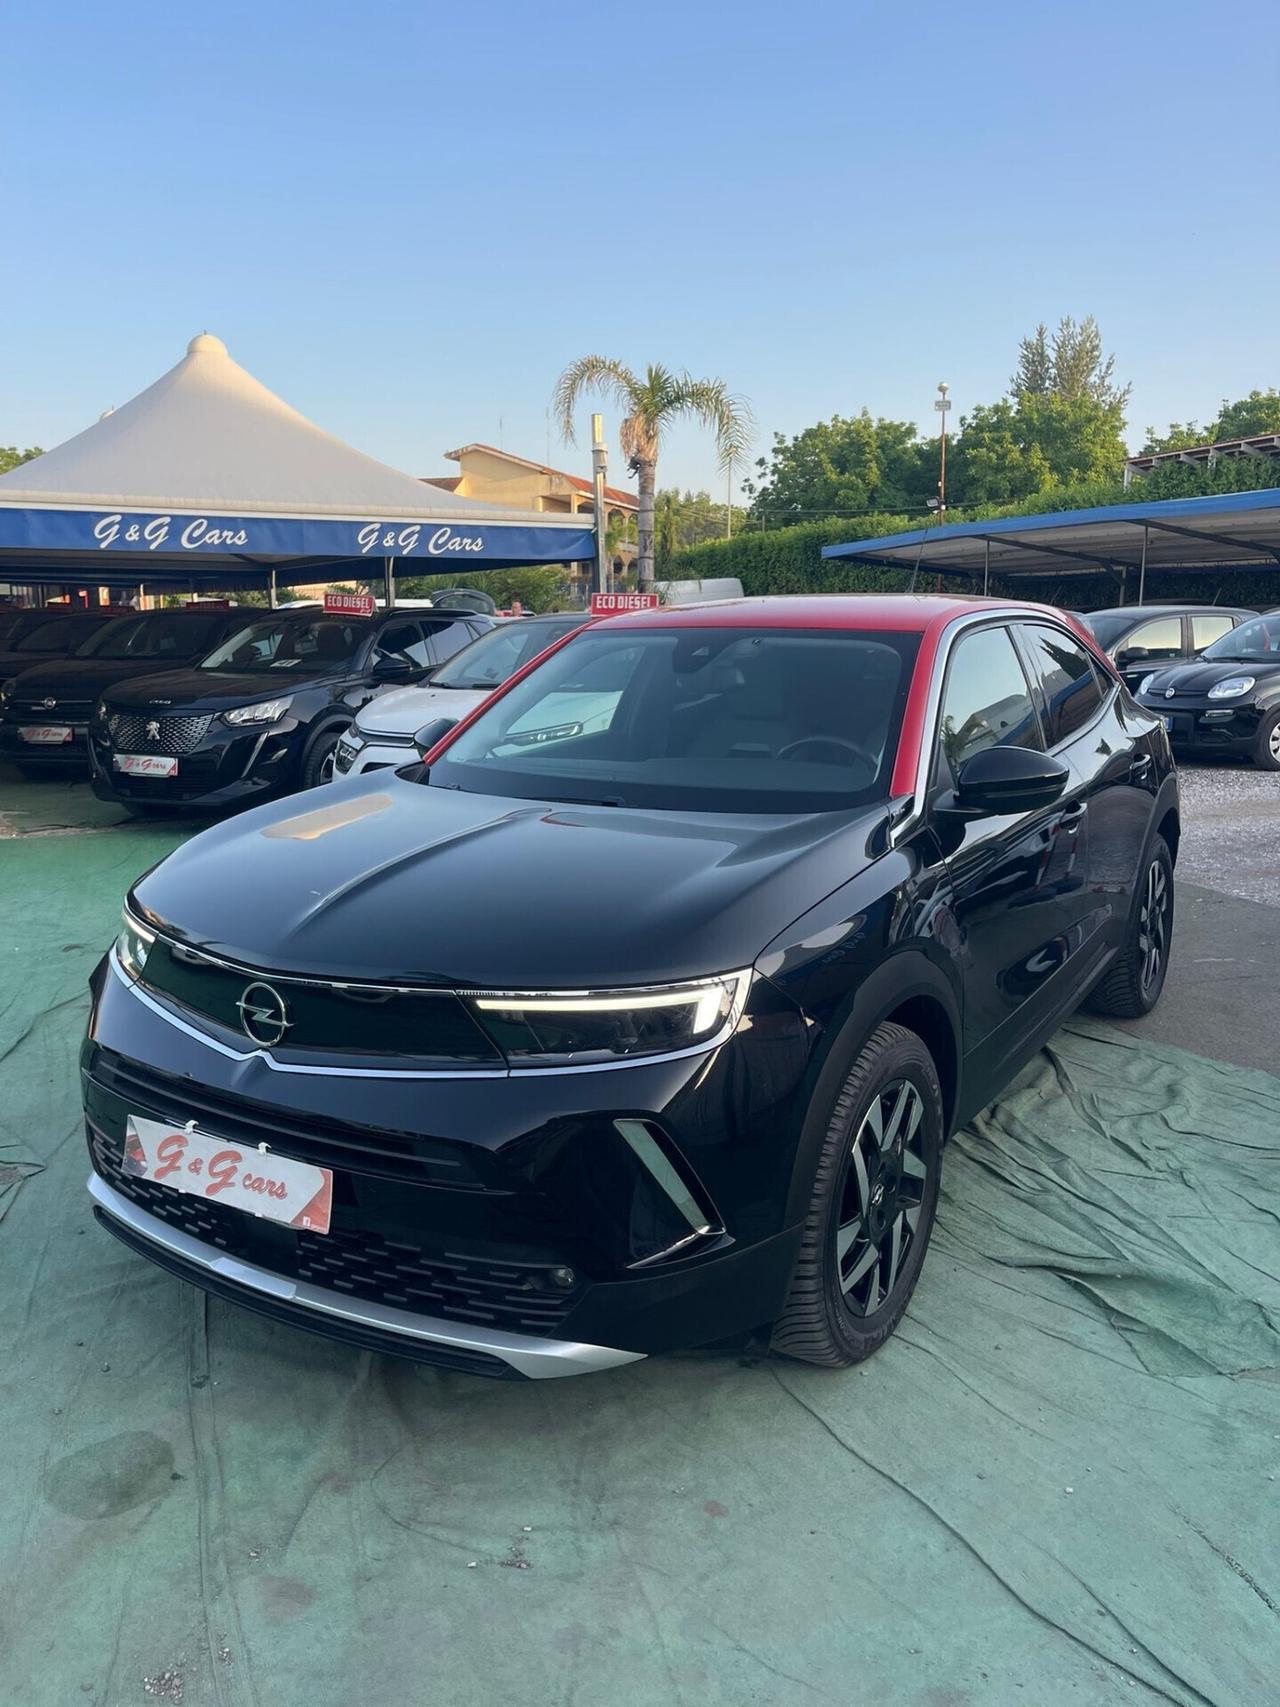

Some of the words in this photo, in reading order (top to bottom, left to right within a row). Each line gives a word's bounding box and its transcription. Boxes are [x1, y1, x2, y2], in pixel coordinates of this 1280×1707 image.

[181, 518, 248, 549] Cars
[428, 527, 484, 555] Cars
[327, 595, 342, 607] ECO
[343, 596, 370, 609] DIESEL
[596, 595, 615, 609] ECO
[242, 1172, 288, 1200] cars
